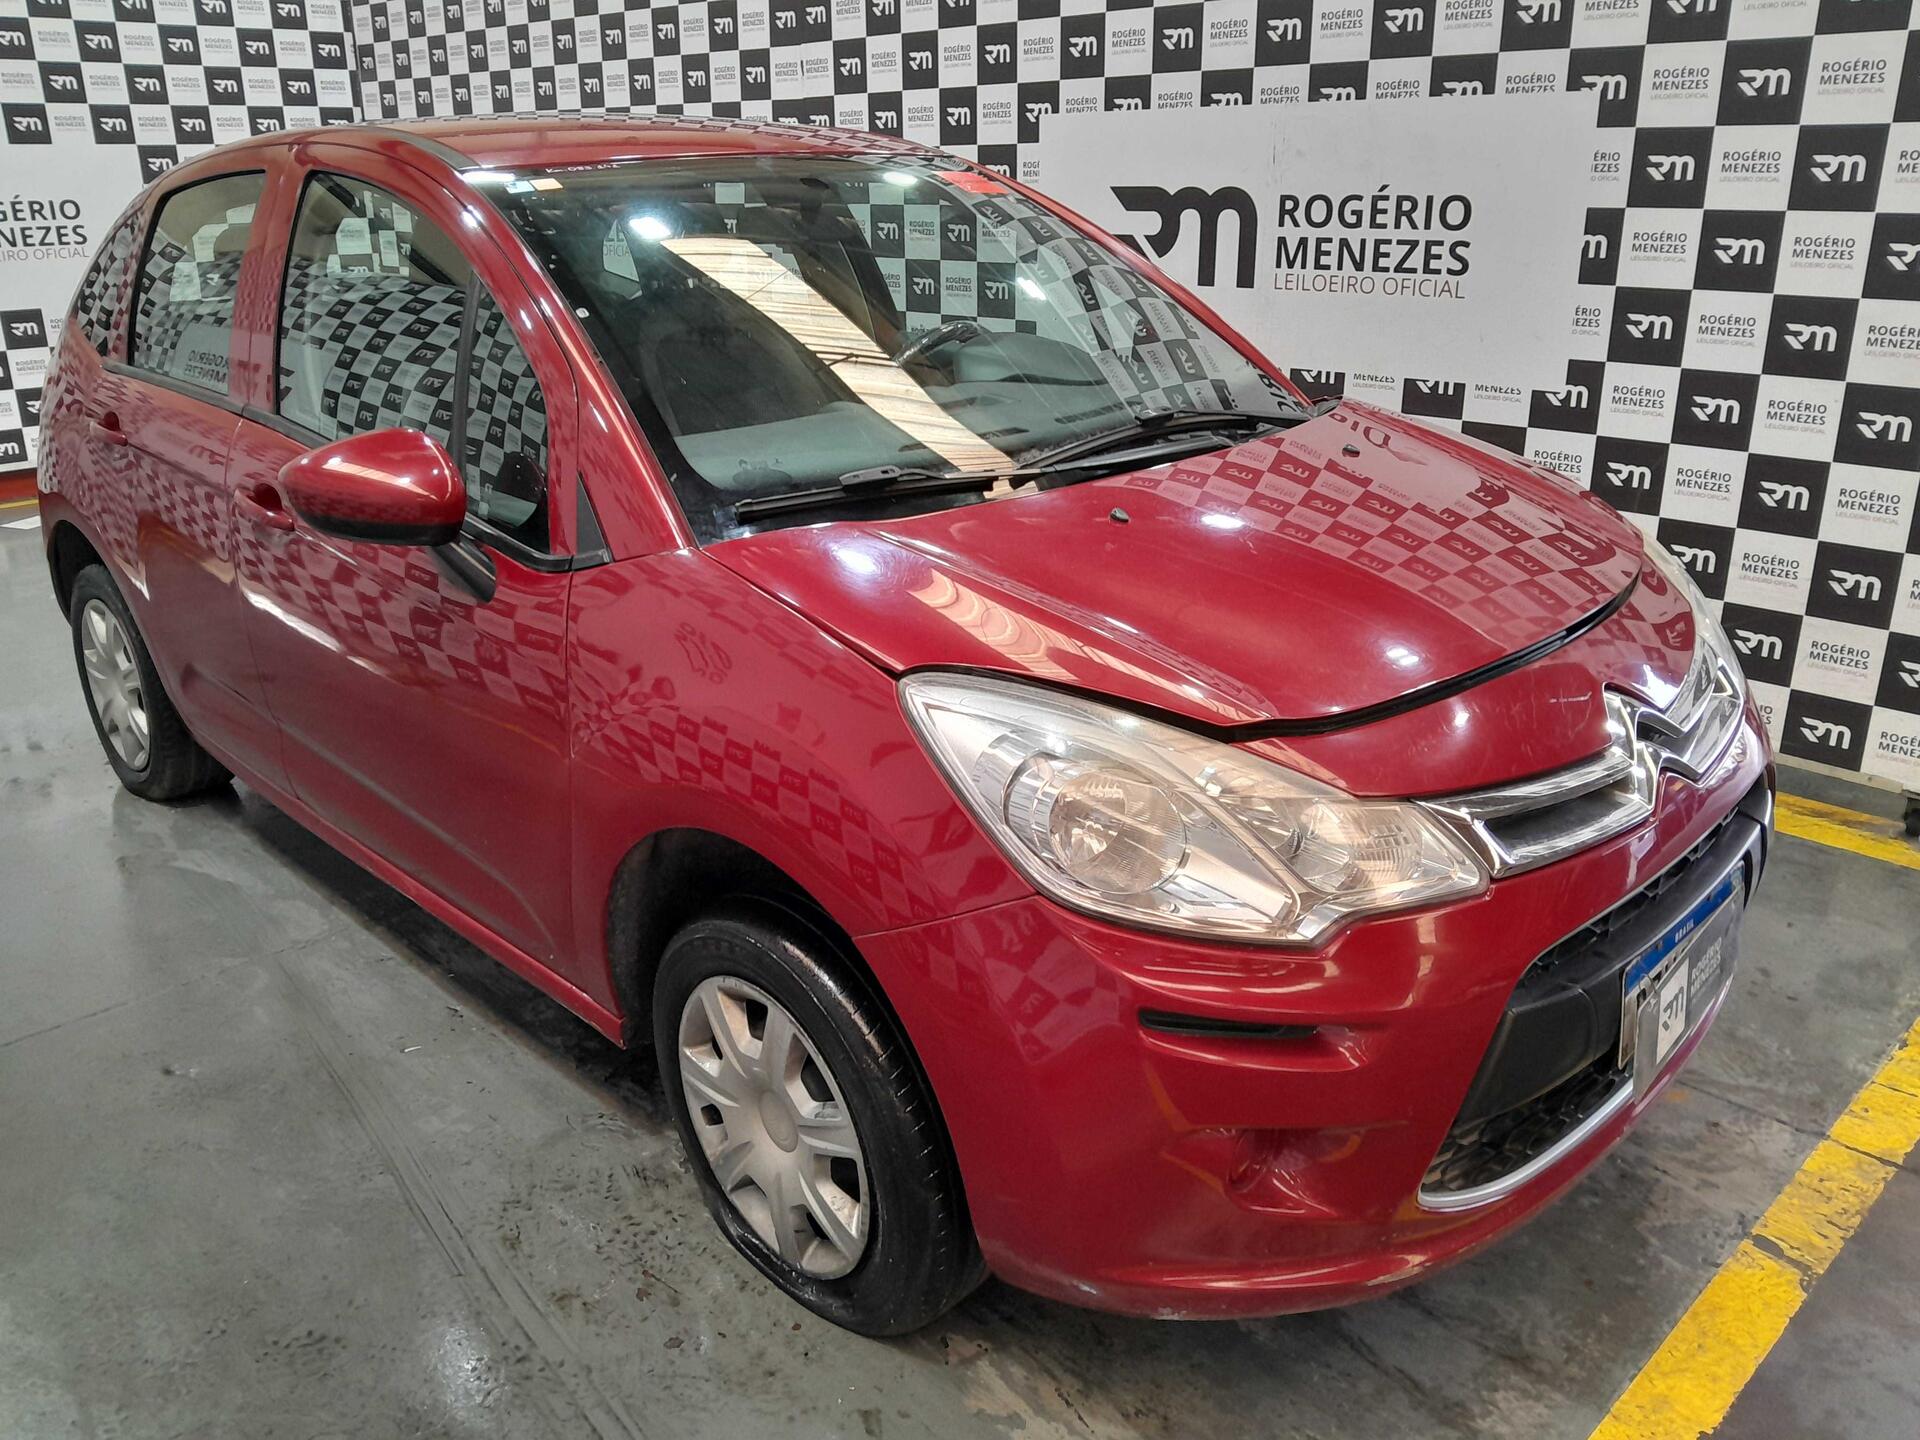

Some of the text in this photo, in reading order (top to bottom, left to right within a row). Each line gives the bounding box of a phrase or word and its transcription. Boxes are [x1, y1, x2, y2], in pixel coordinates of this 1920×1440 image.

[1321, 8, 1364, 21] ROGÉRIO
[1444, 9, 1493, 21] MENEZES
[1210, 18, 1248, 31] ROGÉRIO
[1320, 20, 1363, 31] MENEZES
[1111, 27, 1146, 38] ROGÉRIO
[1210, 29, 1248, 40] MENEZES
[1023, 36, 1054, 46] ROGÉRIO
[1111, 37, 1146, 47] MENEZES
[1023, 45, 1054, 55] MENEZES
[1821, 58, 1886, 71] ROGÉRIO
[1653, 65, 1709, 79] ROGÉRIO
[1819, 73, 1884, 84] MENEZES
[1376, 78, 1420, 91] ROGÉRIO
[1506, 72, 1556, 86] ROGÉRIO
[1651, 78, 1708, 91] MENEZES
[1158, 89, 1192, 100] ROGÉRIO
[1260, 85, 1300, 97] ROGÉRIO
[1066, 95, 1096, 105] ROGÉRIO
[1722, 148, 1781, 161] ROGÉRIO
[1720, 162, 1780, 173] MENEZES
[1277, 184, 1472, 232] ROGÉRIO
[1633, 230, 1687, 242] ROGÉRIO
[1794, 234, 1855, 248] ROGÉRIO
[1631, 242, 1685, 253] MENEZES
[1792, 248, 1853, 260] MENEZES
[1275, 236, 1471, 276] MENEZES
[1273, 273, 1465, 299] LEILOEIRO OFICIAL
[1699, 313, 1756, 327] ROGÉRIO
[1697, 325, 1755, 338] MENEZES
[1868, 324, 1920, 341] ROGÉRI
[1613, 385, 1664, 398] ROGÉRIO
[1611, 395, 1663, 409] MENEZES
[1768, 399, 1827, 414] ROGÉRIO
[1766, 410, 1825, 425] MENEZES
[1534, 450, 1583, 464] ROGÉRIO
[1676, 467, 1732, 482] ROGÉRIO
[1675, 477, 1730, 493] MENEZES
[1838, 487, 1900, 505] ROGÉRIO
[1836, 497, 1898, 516] MENEZES
[1742, 552, 1799, 569] ROGÉRIO
[1740, 562, 1798, 580] MENEZES
[1811, 640, 1869, 659] ROGÉRIO
[1809, 650, 1867, 670] MENEZES
[1880, 731, 1920, 748] ROGÉ
